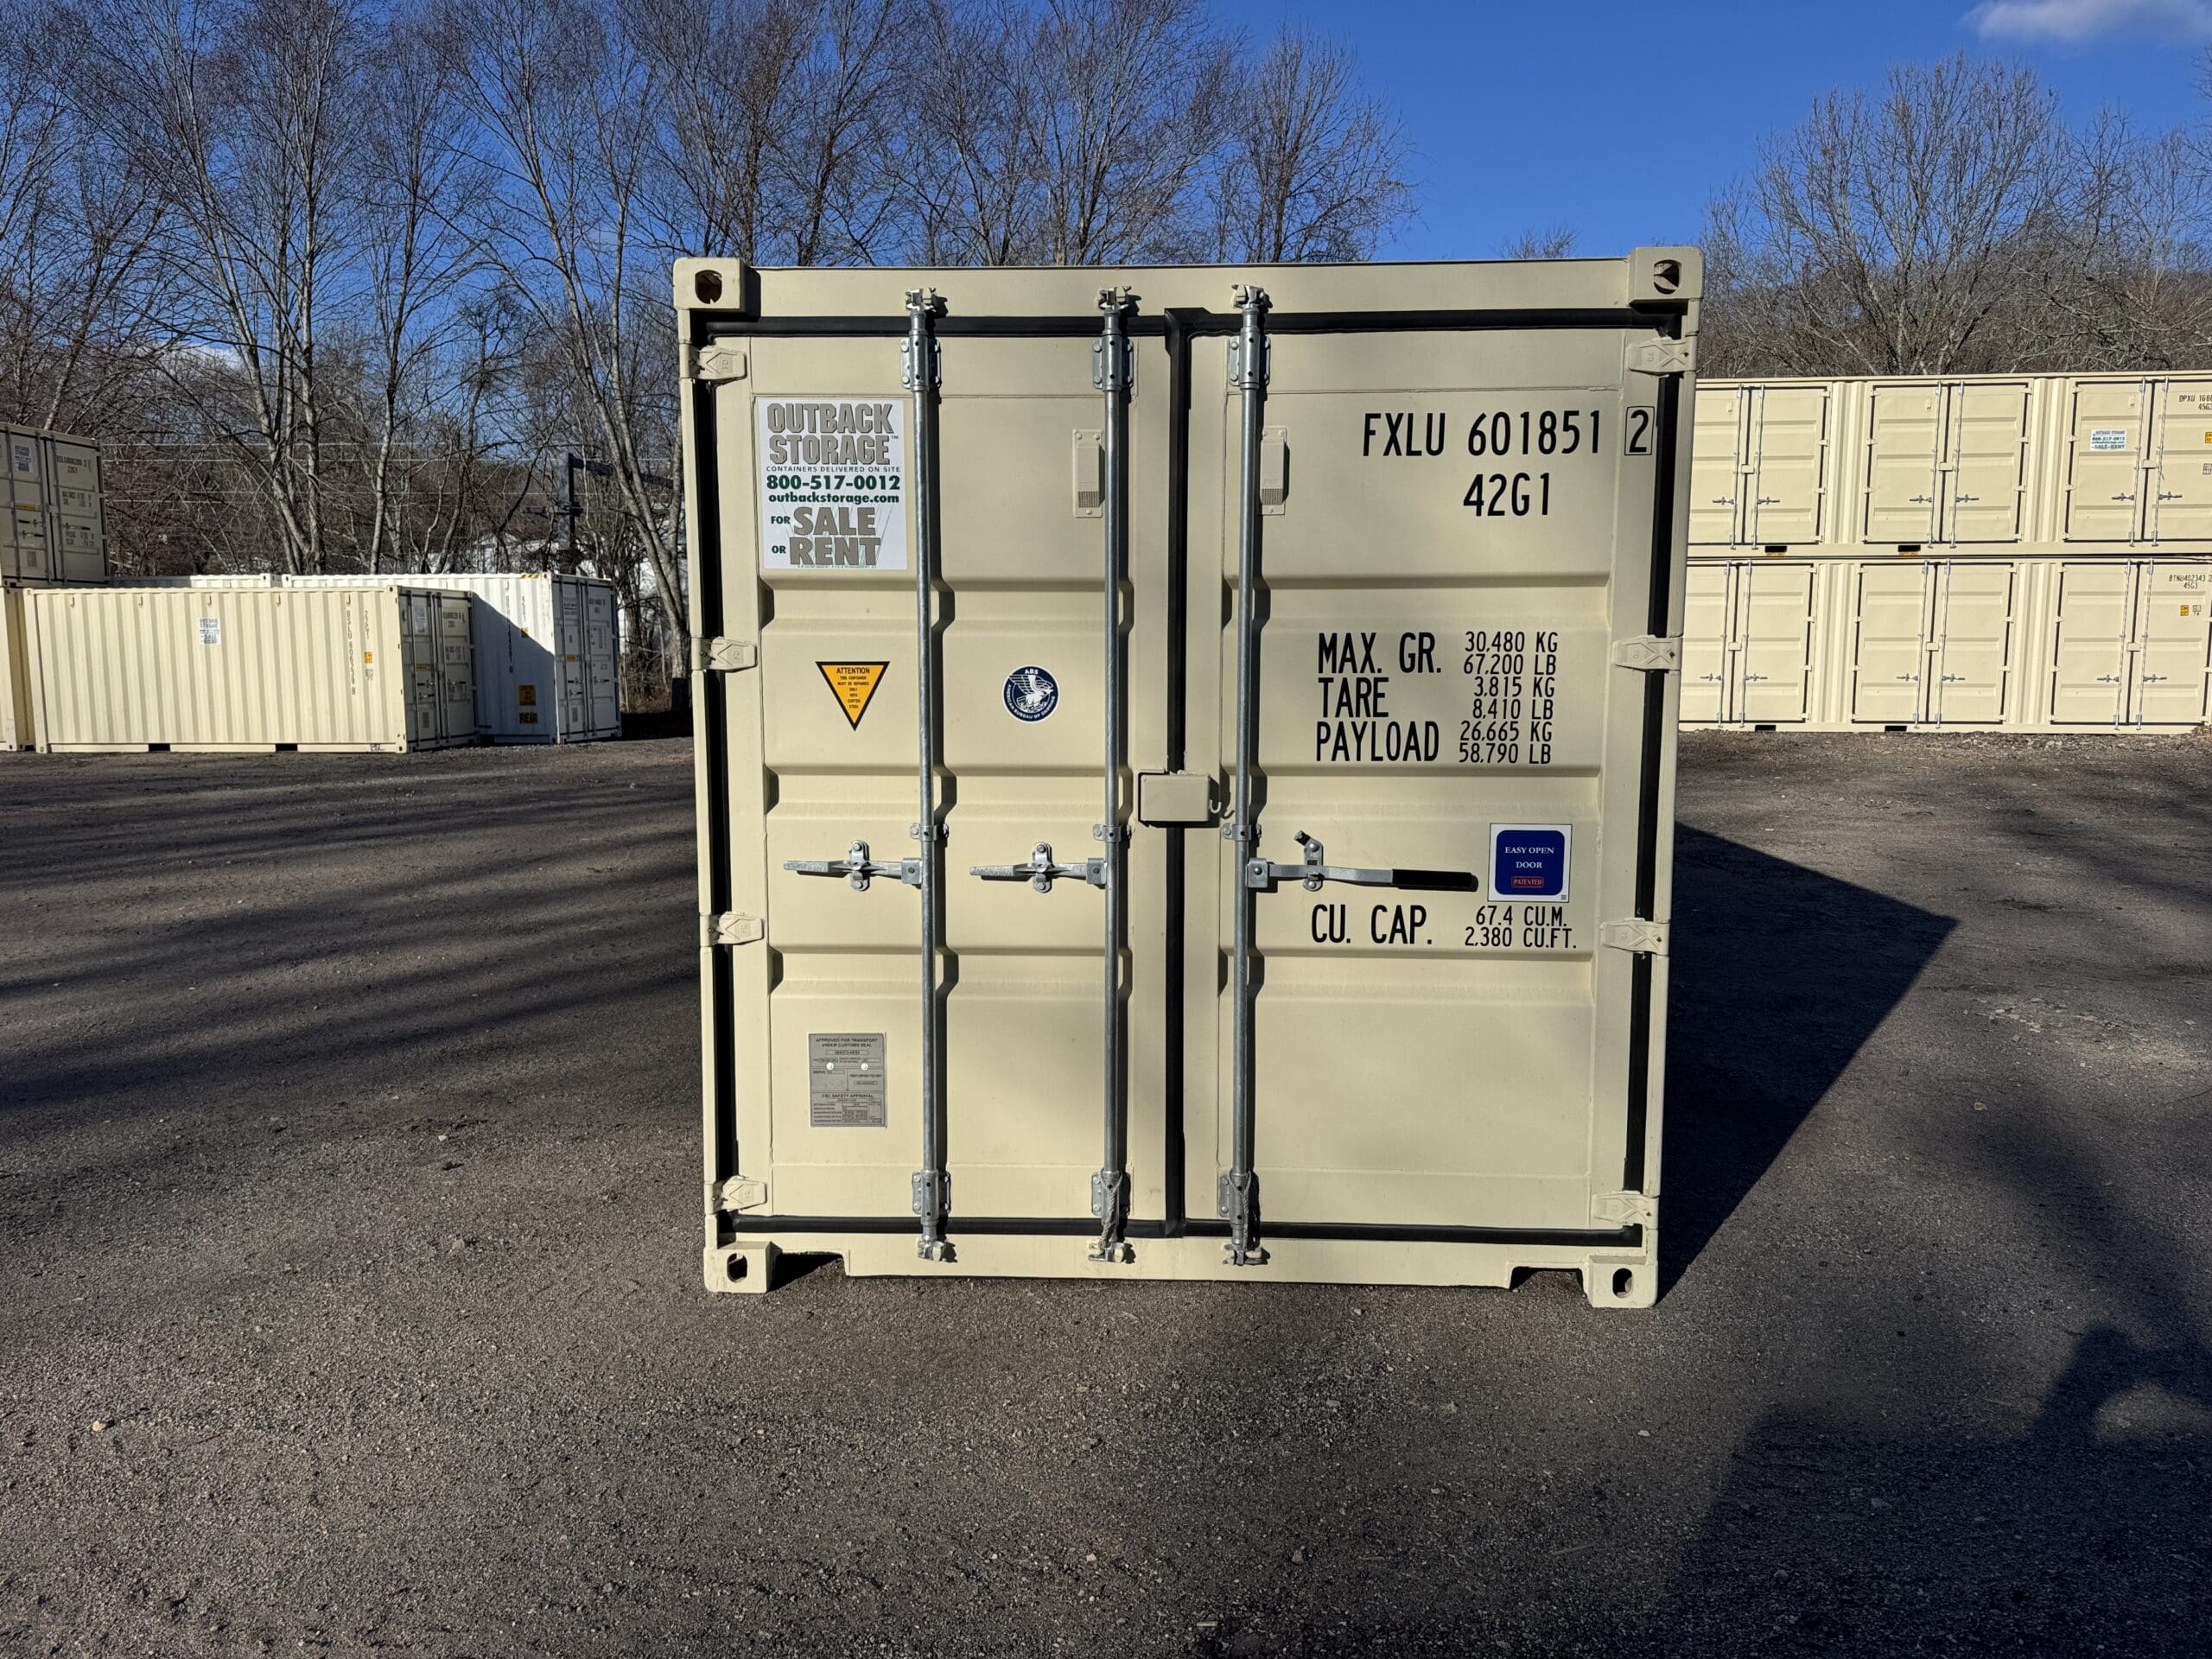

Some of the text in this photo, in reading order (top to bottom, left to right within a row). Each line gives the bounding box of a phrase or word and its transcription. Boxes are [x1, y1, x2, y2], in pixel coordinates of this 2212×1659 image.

[766, 403, 894, 434] OUTBACK
[1363, 409, 1649, 456] FXLU 601851 2
[769, 435, 891, 465] STORAGE
[766, 474, 900, 490] 800-517-0012
[769, 492, 899, 505] outbackstorage.com
[1463, 473, 1550, 517] 42G1
[771, 506, 876, 536] FOR SALE
[790, 537, 881, 566] RENT
[1318, 632, 1442, 674] MAX. GR.
[1465, 632, 1558, 653] 30,480 KG
[1464, 654, 1556, 676] 67,200 LB
[1318, 677, 1389, 718] TARE
[1474, 677, 1555, 698] 3,815 KG
[1014, 709, 1033, 719] BUREAU
[1471, 699, 1554, 721] 8,410 LB
[1316, 721, 1440, 762] PAYLOAD
[1459, 721, 1552, 742] 26,665 KG
[1459, 743, 1551, 764] 58,790 LB
[1311, 904, 1432, 944] CU. CAP.
[1476, 906, 1567, 927] 67.4 CU.M.
[1465, 926, 1576, 949] 2,380 CU.FT.
